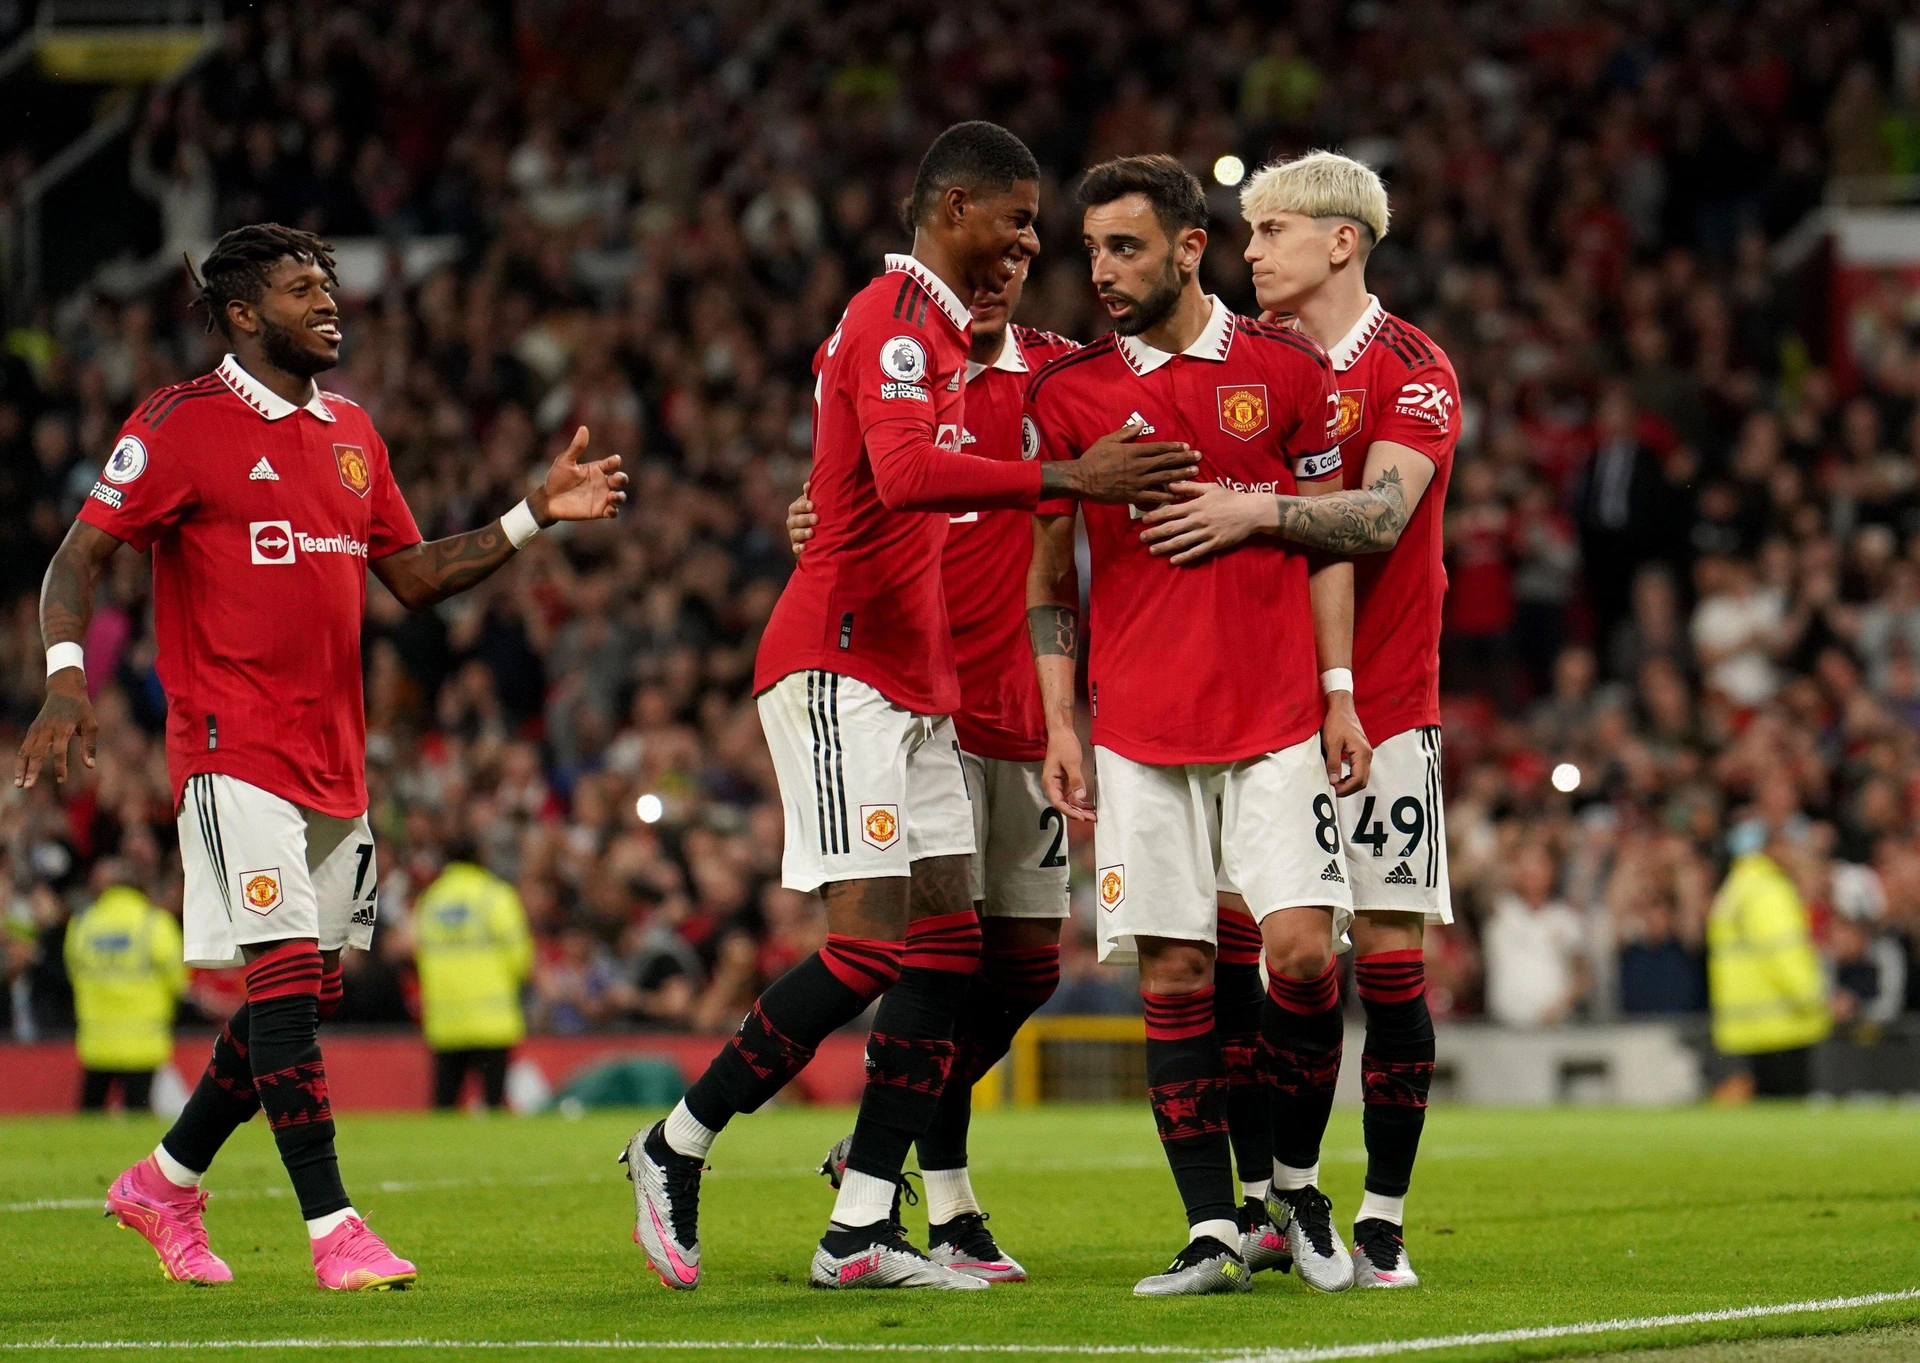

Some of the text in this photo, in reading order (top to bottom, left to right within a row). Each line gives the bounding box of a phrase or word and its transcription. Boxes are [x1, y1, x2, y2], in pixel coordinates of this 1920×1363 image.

[881, 382, 923, 394] No room
[1227, 393, 1260, 407] MANCHESTER
[1233, 421, 1257, 429] UNITED
[1395, 405, 1449, 433] TECHNOL
[960, 435, 977, 444] das
[1320, 451, 1340, 469] Capt
[249, 471, 280, 481] adidas
[94, 481, 101, 490] o
[100, 484, 122, 500] room
[294, 532, 368, 558] TeamViewe
[1312, 793, 1340, 855] 8
[1351, 796, 1425, 857] 49
[1320, 873, 1345, 884] adidas
[1384, 875, 1417, 885] adidas
